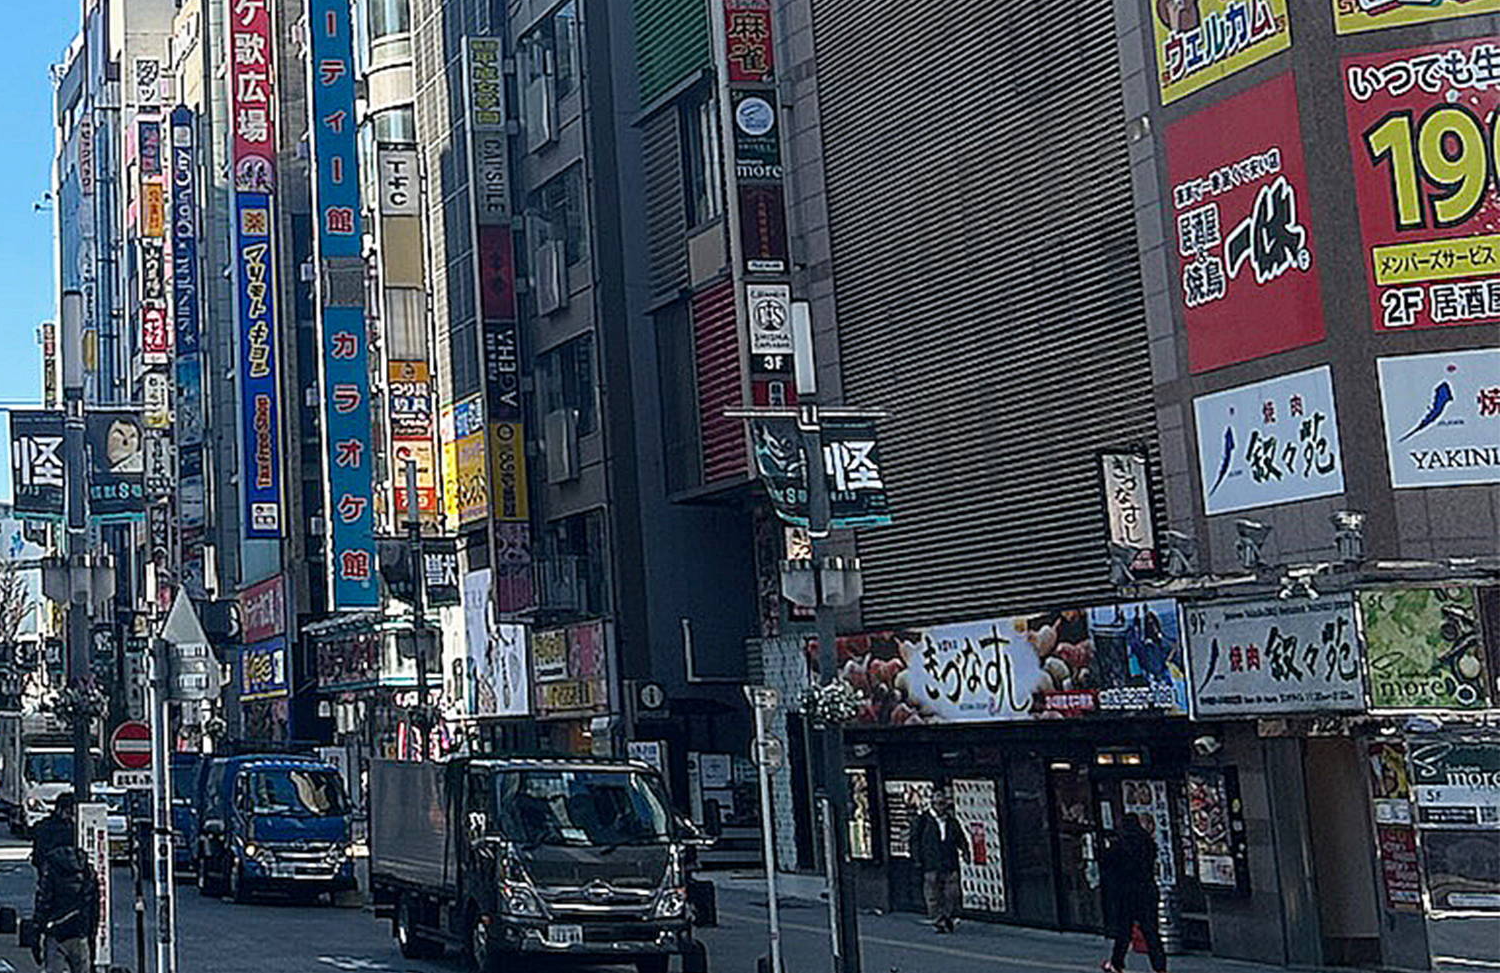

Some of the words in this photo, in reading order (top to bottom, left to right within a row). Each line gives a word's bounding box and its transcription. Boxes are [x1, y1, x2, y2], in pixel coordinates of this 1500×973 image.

[728, 12, 769, 73] 麻雀
[736, 165, 783, 178] more
[1366, 101, 1500, 233] 19
[1381, 245, 1496, 276] メンバーズサービス
[1382, 287, 1424, 327] 2F
[764, 356, 784, 370] 3F
[12, 436, 64, 486] 怪
[331, 332, 370, 580] カラオケ館
[823, 440, 884, 492] 怪
[1245, 412, 1335, 484] 叙々苑
[923, 624, 1032, 711] きづなすし
[1265, 616, 1358, 683] 叙々苑
[1380, 676, 1447, 698] more
